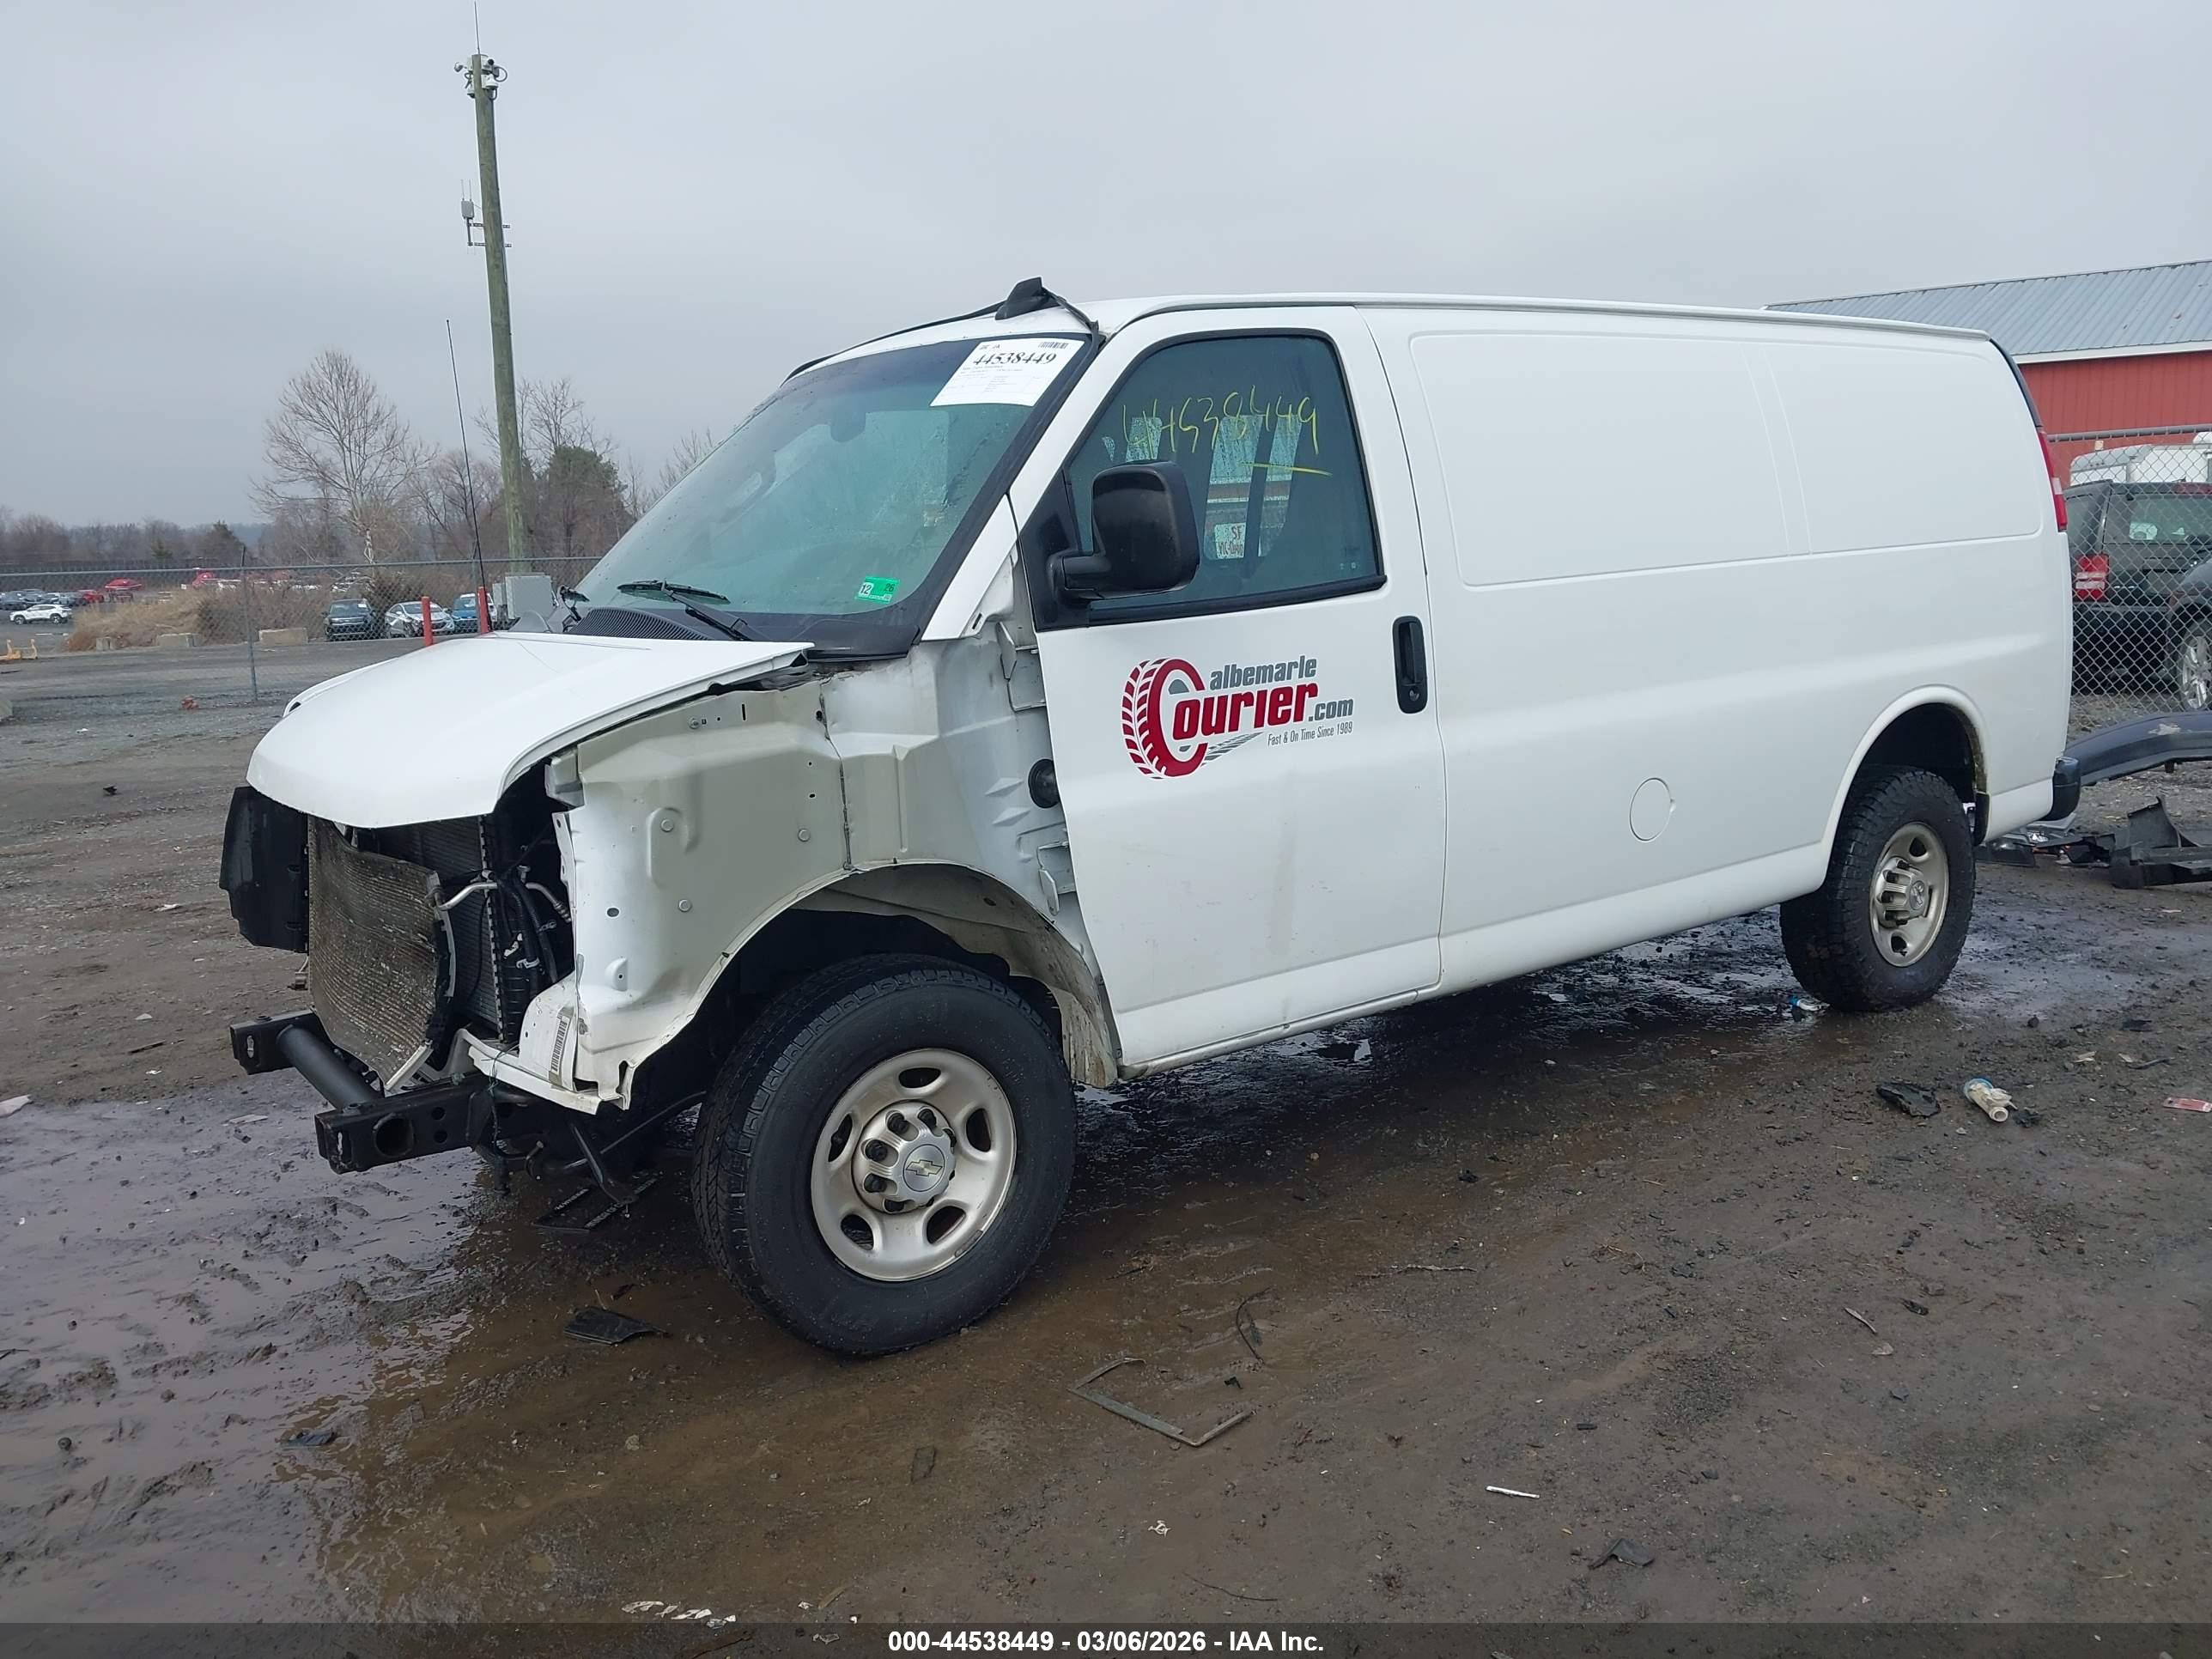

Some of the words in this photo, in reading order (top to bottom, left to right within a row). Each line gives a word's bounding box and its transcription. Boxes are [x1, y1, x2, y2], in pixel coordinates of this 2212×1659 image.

[973, 351, 1057, 365] 44538449
[860, 584, 872, 594] 12
[884, 583, 895, 592] 26
[1209, 655, 1317, 690] albemarle
[1267, 733, 1282, 746] Fast
[1283, 732, 1288, 743] &
[1290, 730, 1299, 742] On
[1301, 728, 1316, 740] Time
[1317, 726, 1334, 738] Since
[1337, 721, 1353, 735] 1989
